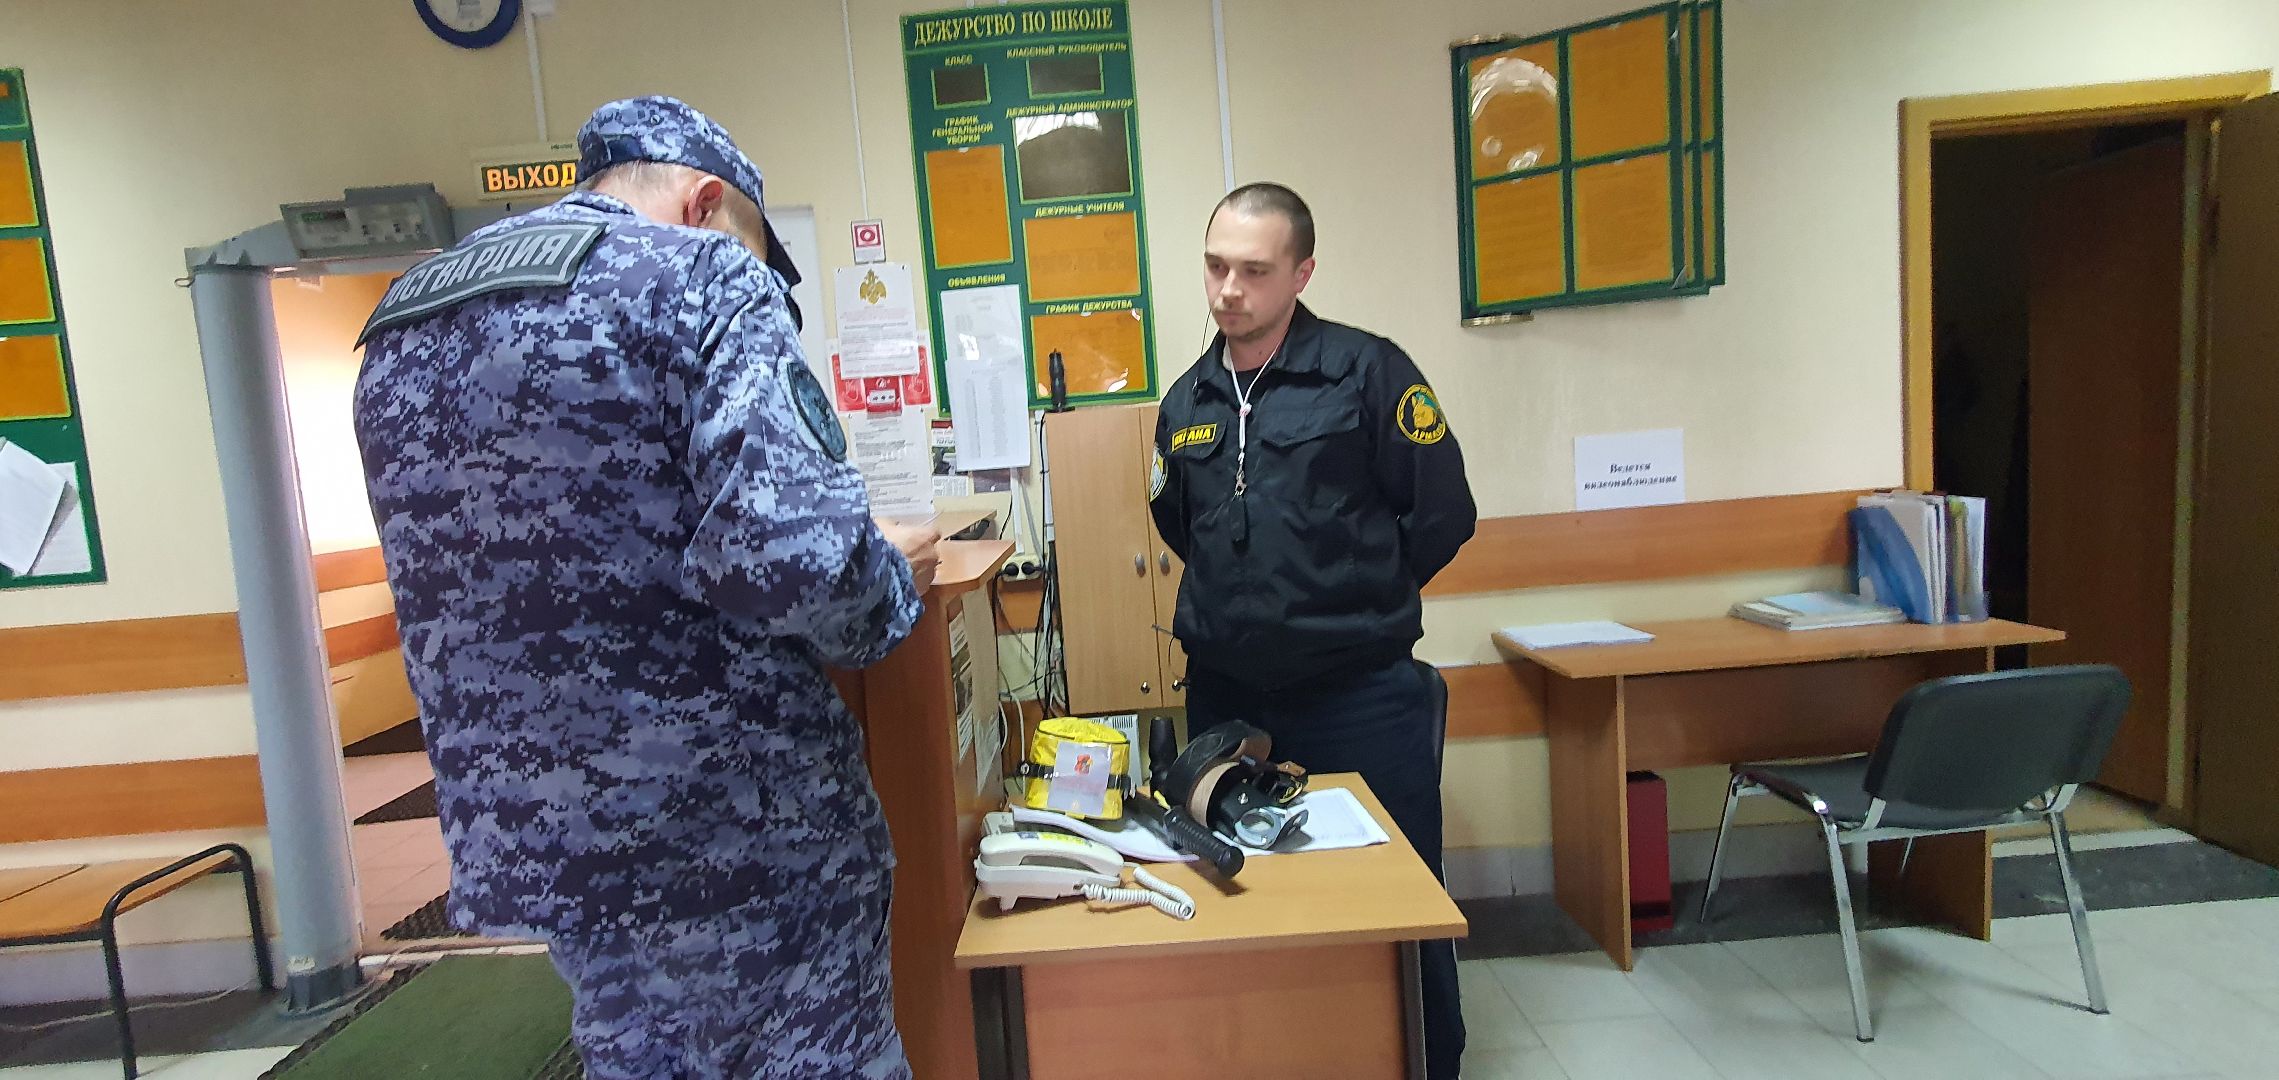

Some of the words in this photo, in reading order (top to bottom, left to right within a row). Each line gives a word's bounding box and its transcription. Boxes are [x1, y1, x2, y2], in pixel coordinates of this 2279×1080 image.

[914, 12, 1015, 47] ДЕЖУРСТВО
[1022, 11, 1045, 33] ПО
[1051, 7, 1112, 32] ШКОЛЕ
[945, 54, 973, 66] КЛАСС
[1006, 103, 1055, 119] ДЕЖУРНЫЙ
[1058, 99, 1134, 114] АДМИНИСТРАТОР
[945, 115, 979, 128] ГРАФИК
[932, 122, 993, 137] ГЕНЕРАЛЬНОЙ
[947, 134, 980, 145] УБОРКИ
[487, 162, 576, 192] ВЫХОД
[1035, 206, 1084, 218] ДЕЖУРНЫЕ
[1087, 201, 1125, 212] УЧИТЕЛЯ
[383, 234, 574, 308] ОСГВАРДИЯ
[948, 273, 1006, 287] ОБЪЯВЛЕНИЯ
[1045, 304, 1080, 314] ГРАФИК
[1083, 299, 1133, 313] ДЕЖУРСТВА
[1609, 463, 1651, 474] Ведется
[1584, 475, 1678, 490] видеонаблюдение
